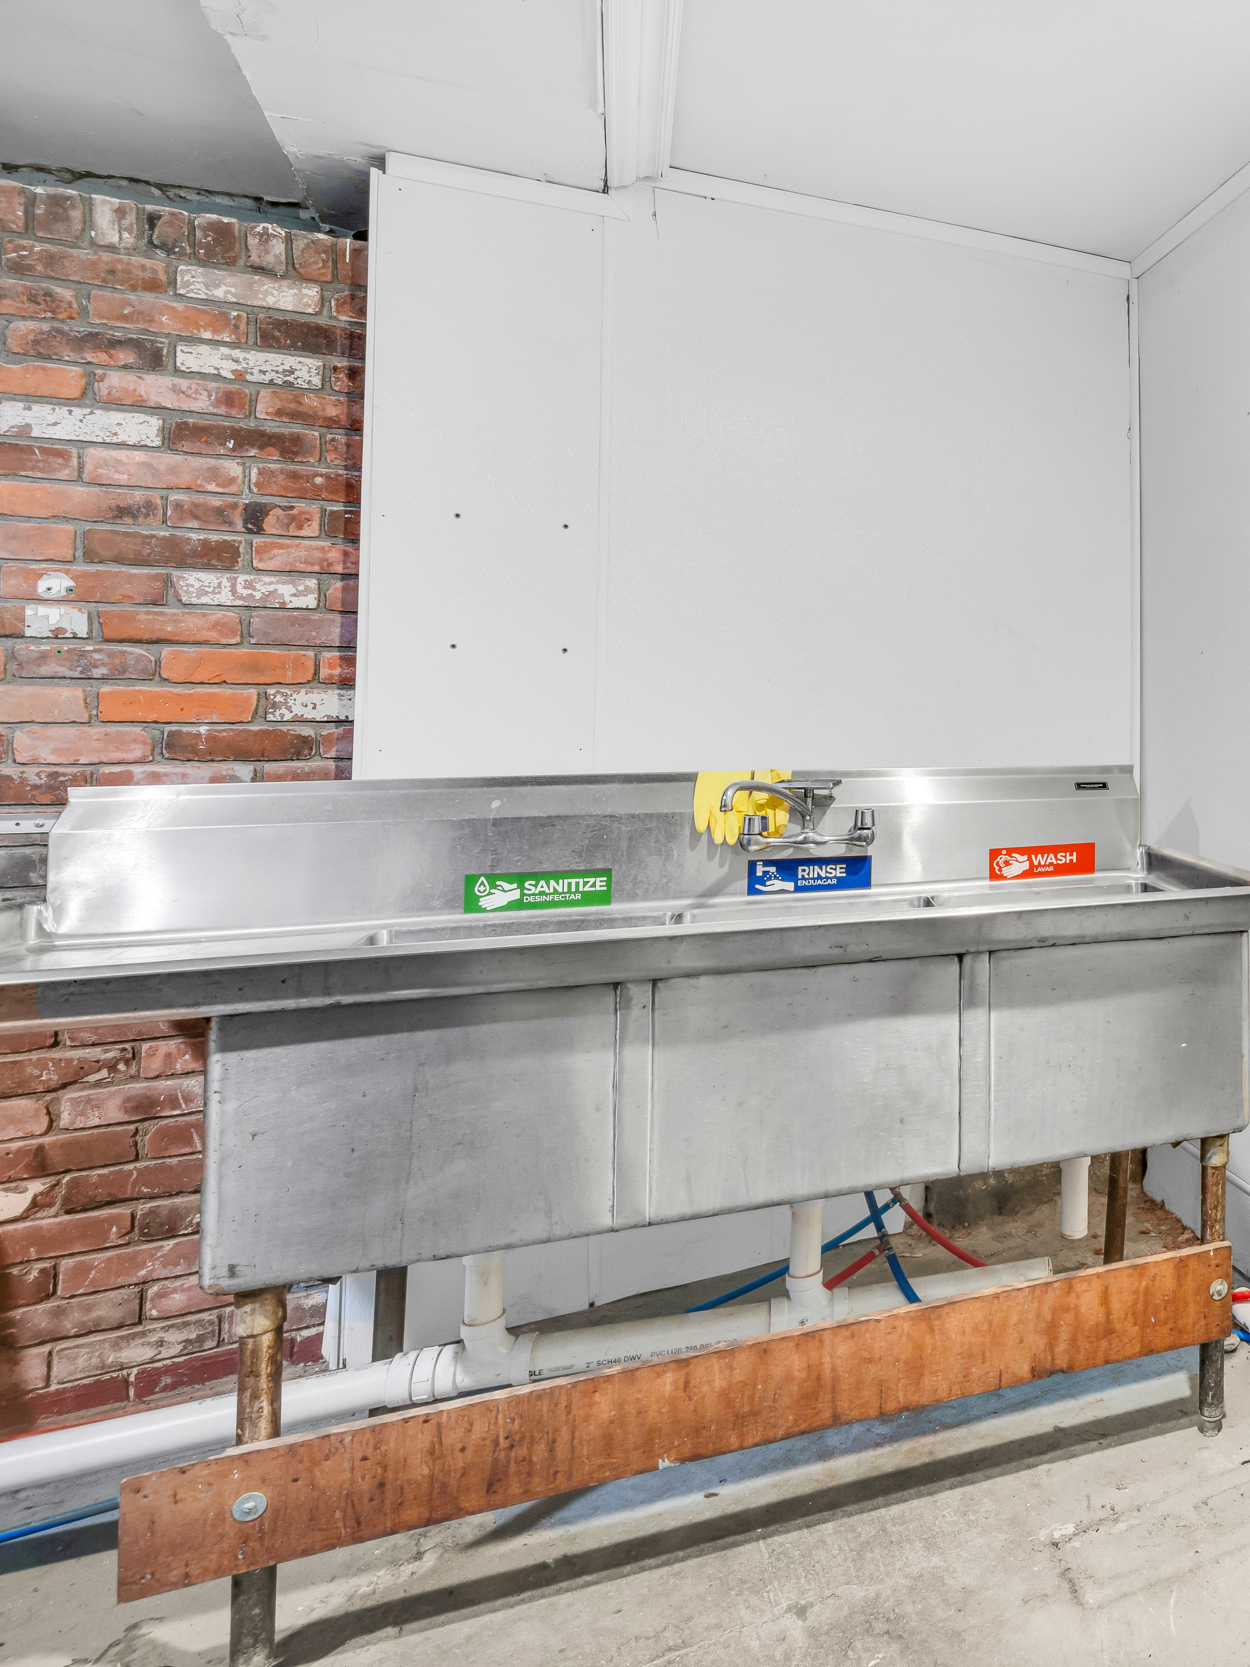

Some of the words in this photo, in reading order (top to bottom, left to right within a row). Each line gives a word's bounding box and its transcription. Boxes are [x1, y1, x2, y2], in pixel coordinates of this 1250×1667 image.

[1031, 852, 1077, 866] WASH
[797, 864, 847, 879] RINSE
[523, 876, 607, 894] SANITIZE
[797, 878, 838, 887] ENJUAGAR
[523, 893, 582, 903] DESINFECTAR
[595, 1357, 622, 1367] SCH40
[623, 1353, 643, 1363] DWV
